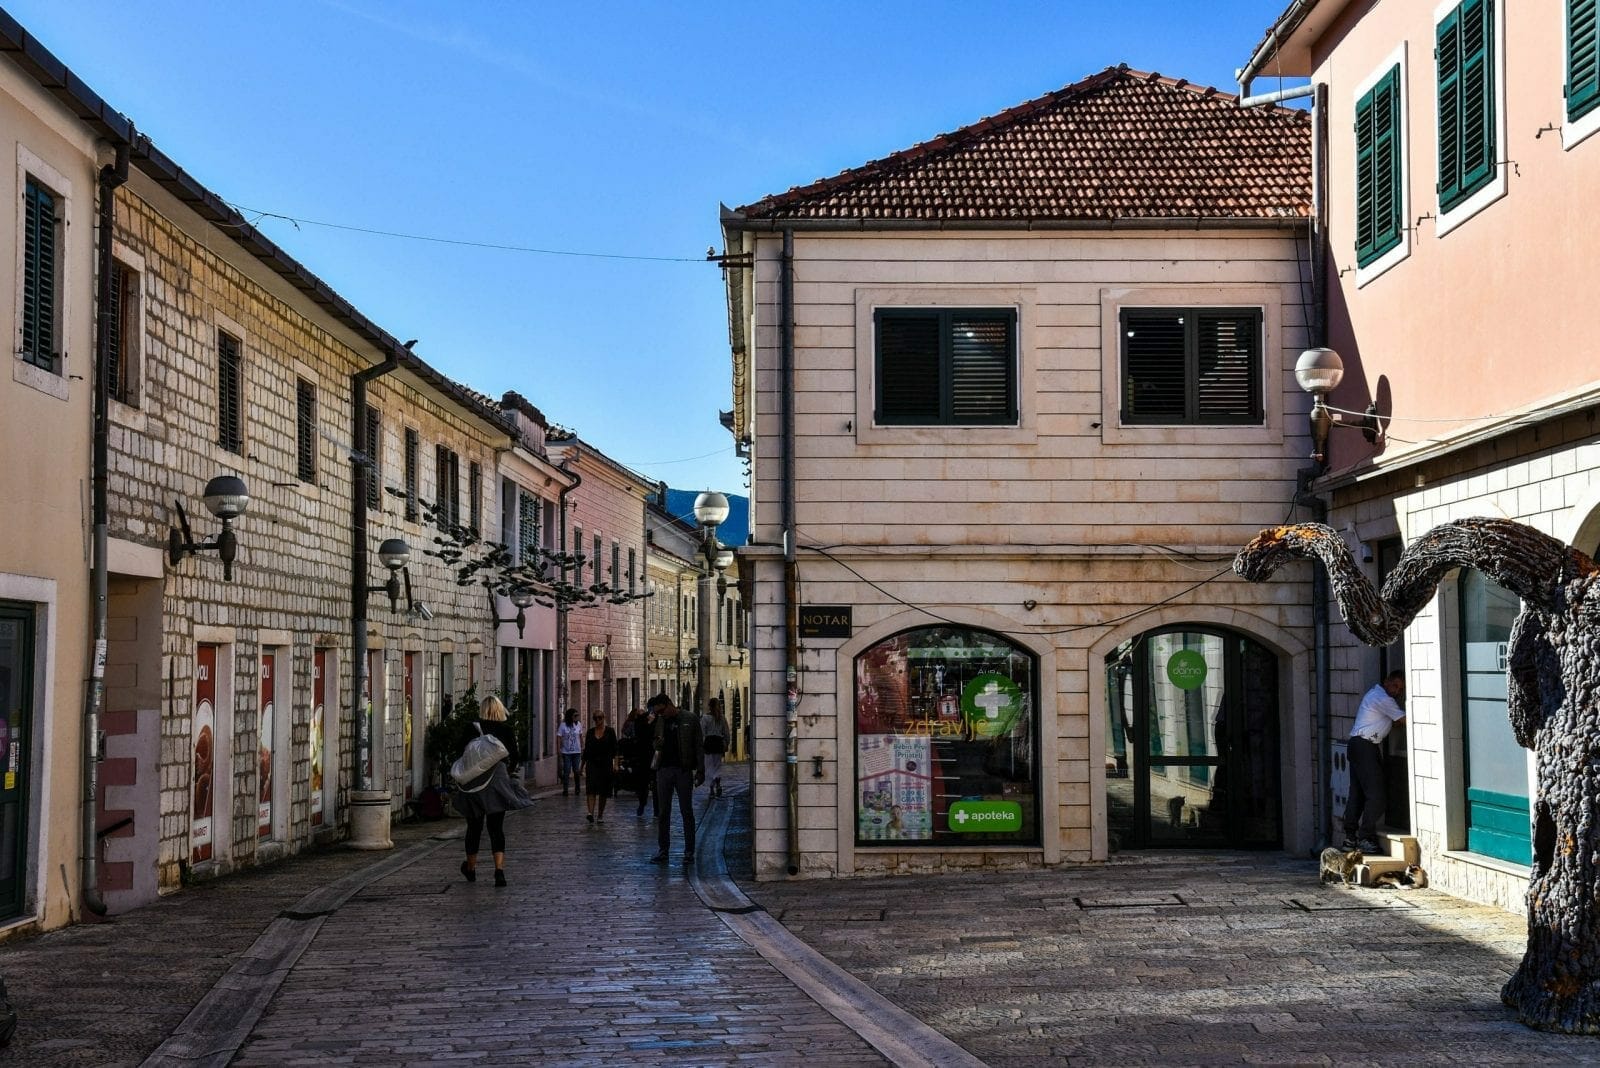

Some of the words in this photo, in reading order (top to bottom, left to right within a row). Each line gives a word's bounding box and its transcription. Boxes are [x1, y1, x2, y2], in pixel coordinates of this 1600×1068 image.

[803, 615, 849, 625] NOTAR
[904, 711, 990, 743] zdravlje
[971, 811, 1015, 822] apoteka
